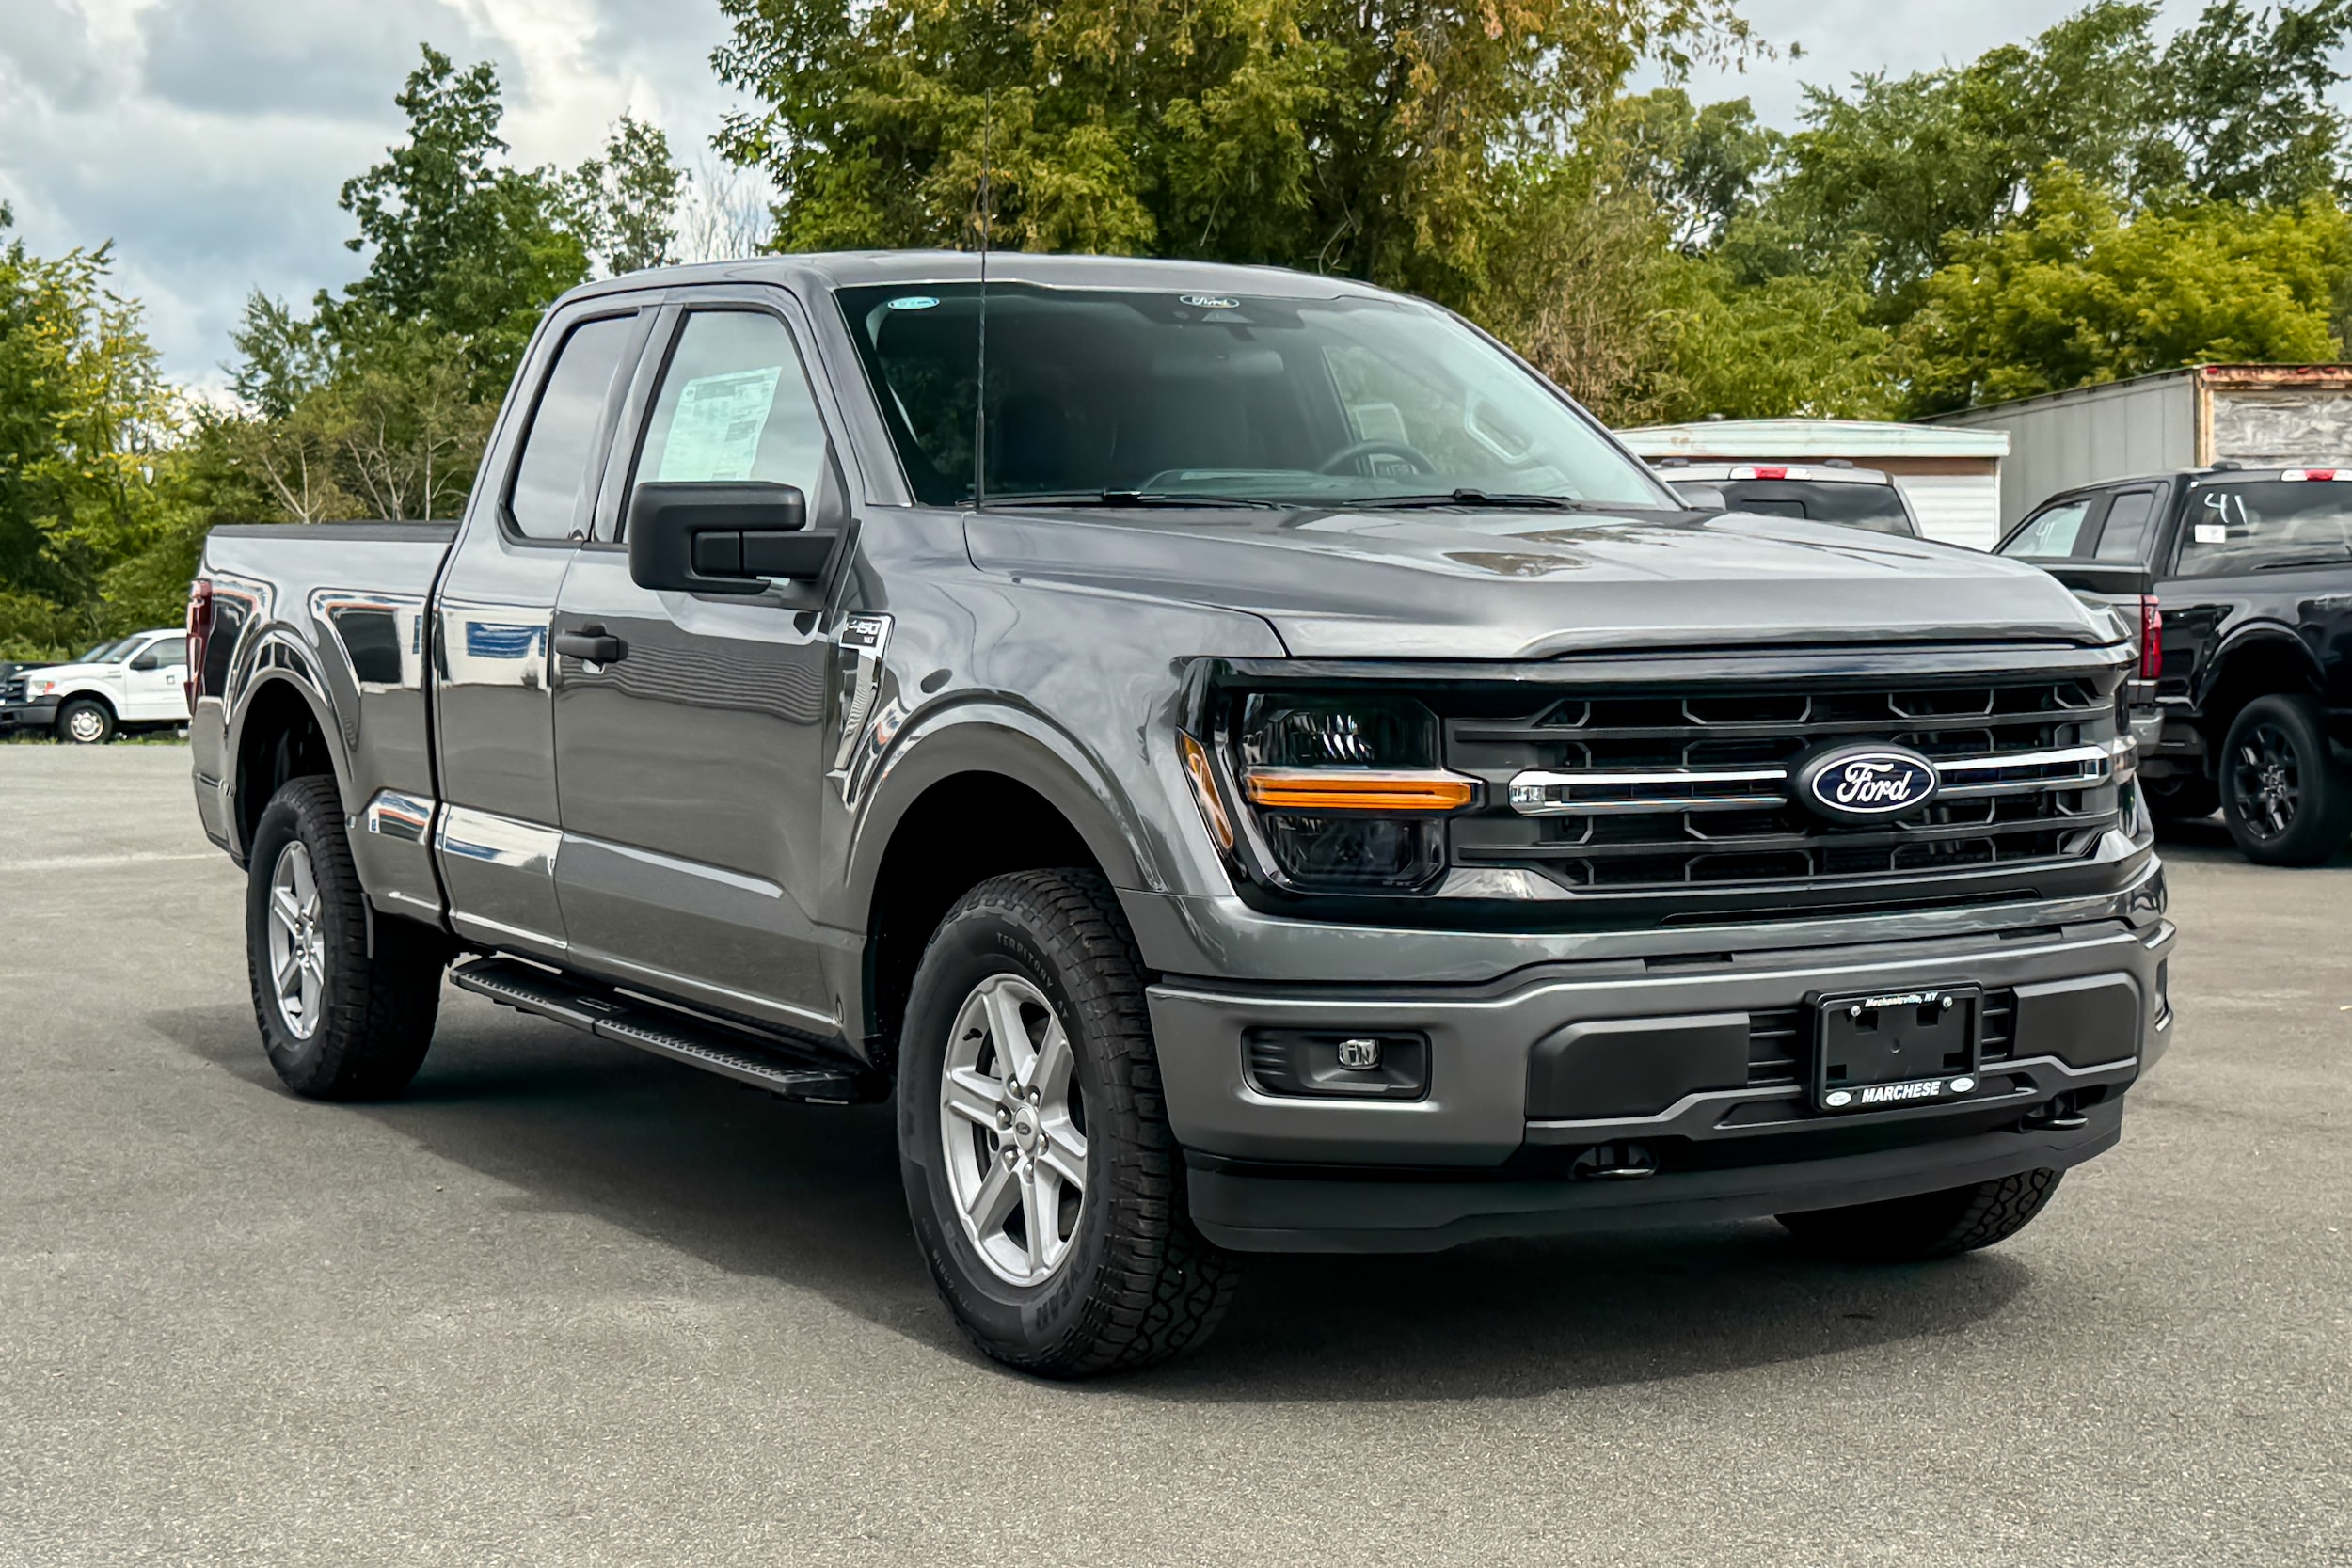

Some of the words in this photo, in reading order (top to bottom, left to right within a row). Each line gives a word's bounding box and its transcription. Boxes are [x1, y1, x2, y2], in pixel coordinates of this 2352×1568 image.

[2204, 492, 2248, 525] 41
[2035, 520, 2056, 546] 41
[1836, 762, 1912, 803] Ford
[996, 931, 1054, 989] TERRITORY
[1861, 1081, 1942, 1103] MARCHESE
